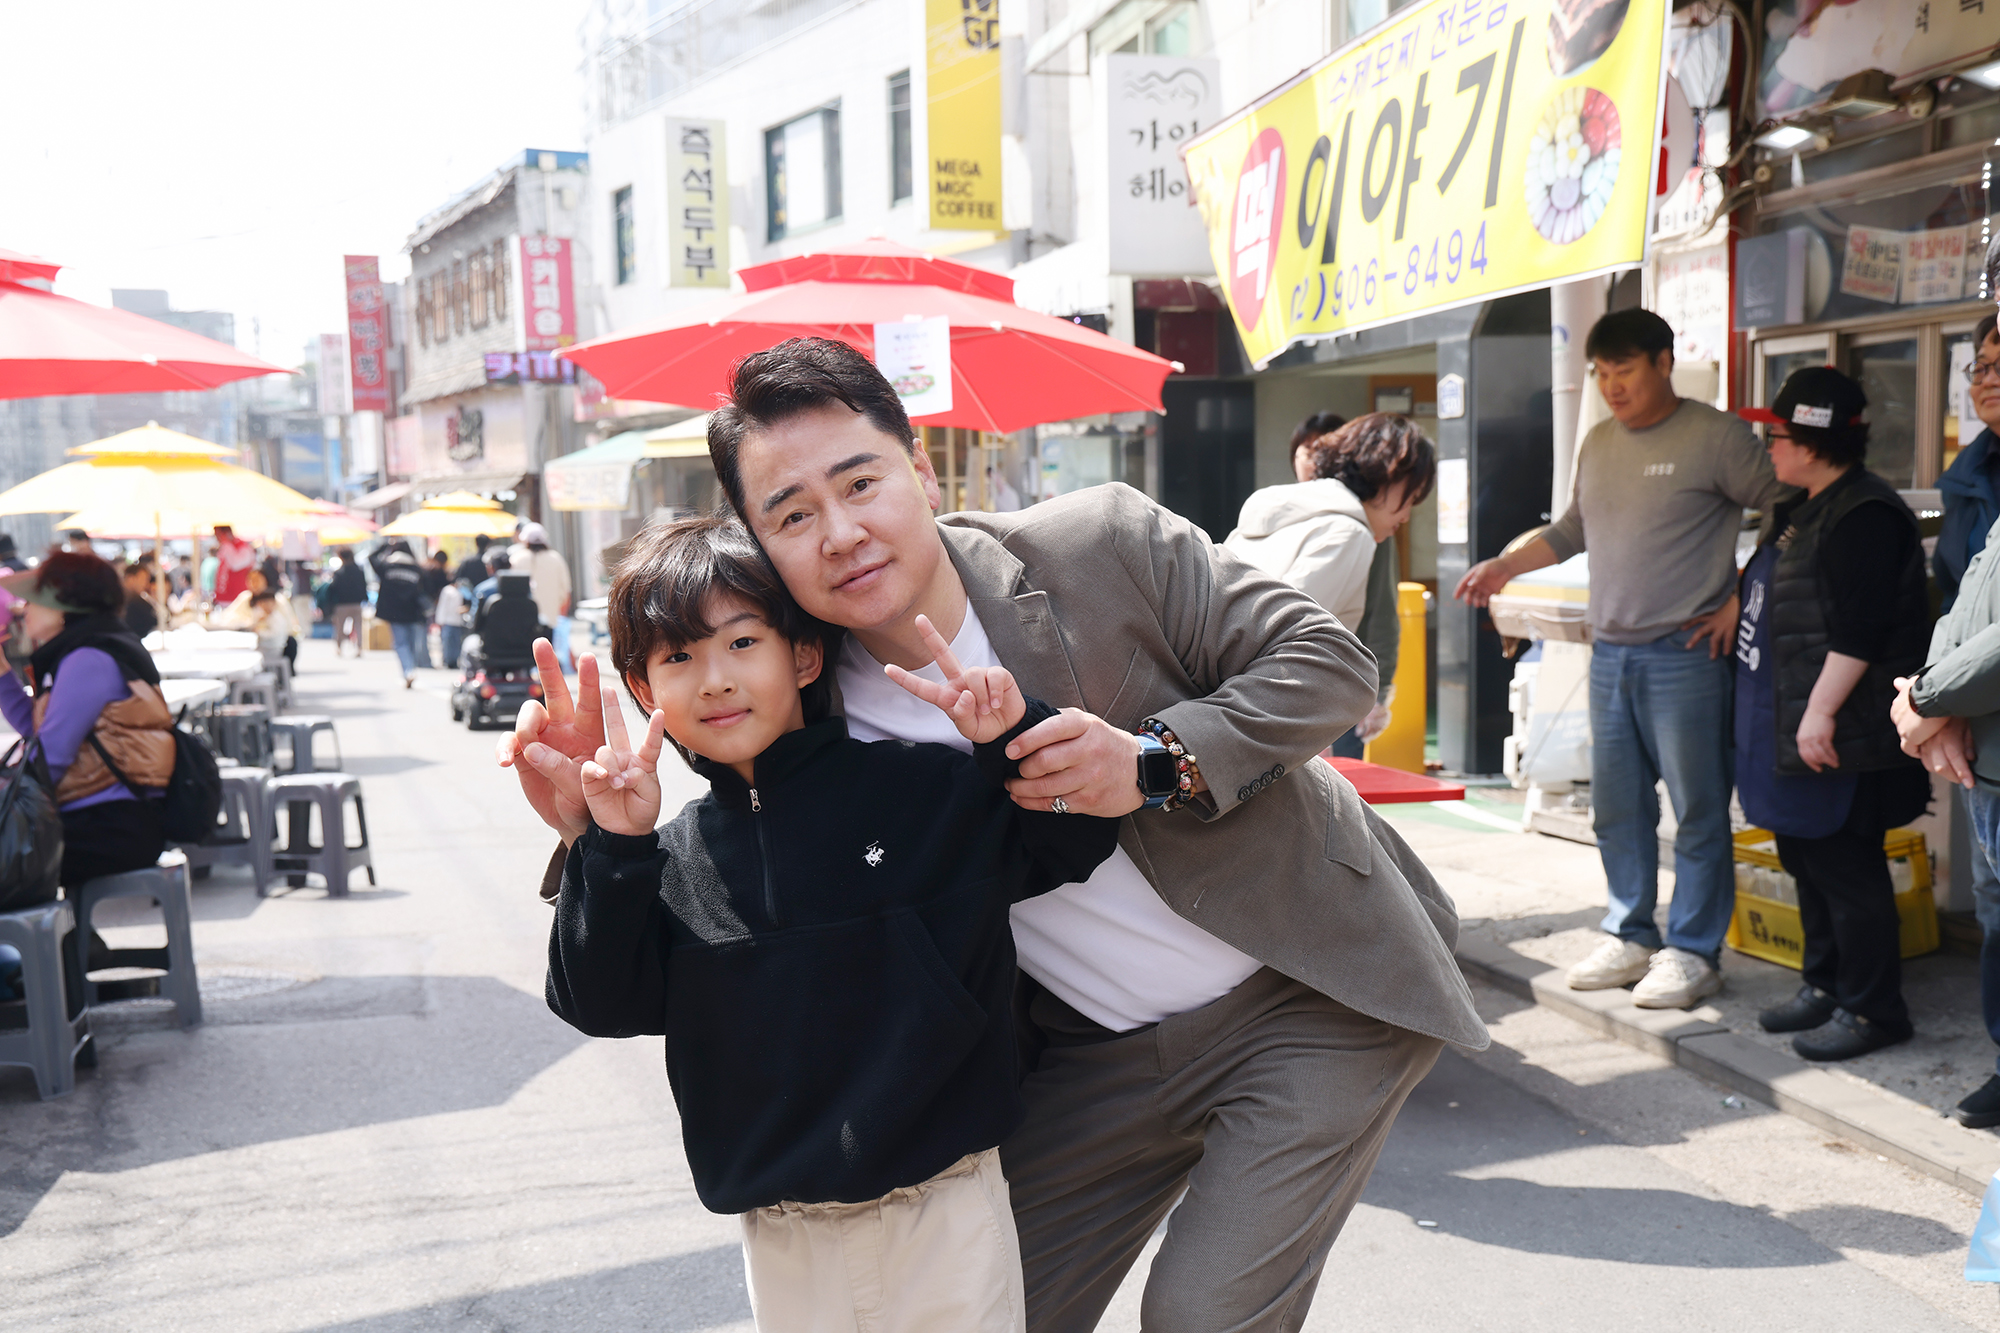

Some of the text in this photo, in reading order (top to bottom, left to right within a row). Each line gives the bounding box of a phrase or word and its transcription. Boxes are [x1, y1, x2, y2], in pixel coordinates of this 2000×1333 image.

[936, 160, 981, 176] MEGA
[1235, 17, 1526, 301] 떡 이야기
[936, 181, 974, 198] MGC
[682, 126, 715, 279] 즉석두부
[936, 200, 996, 219] COFFEE
